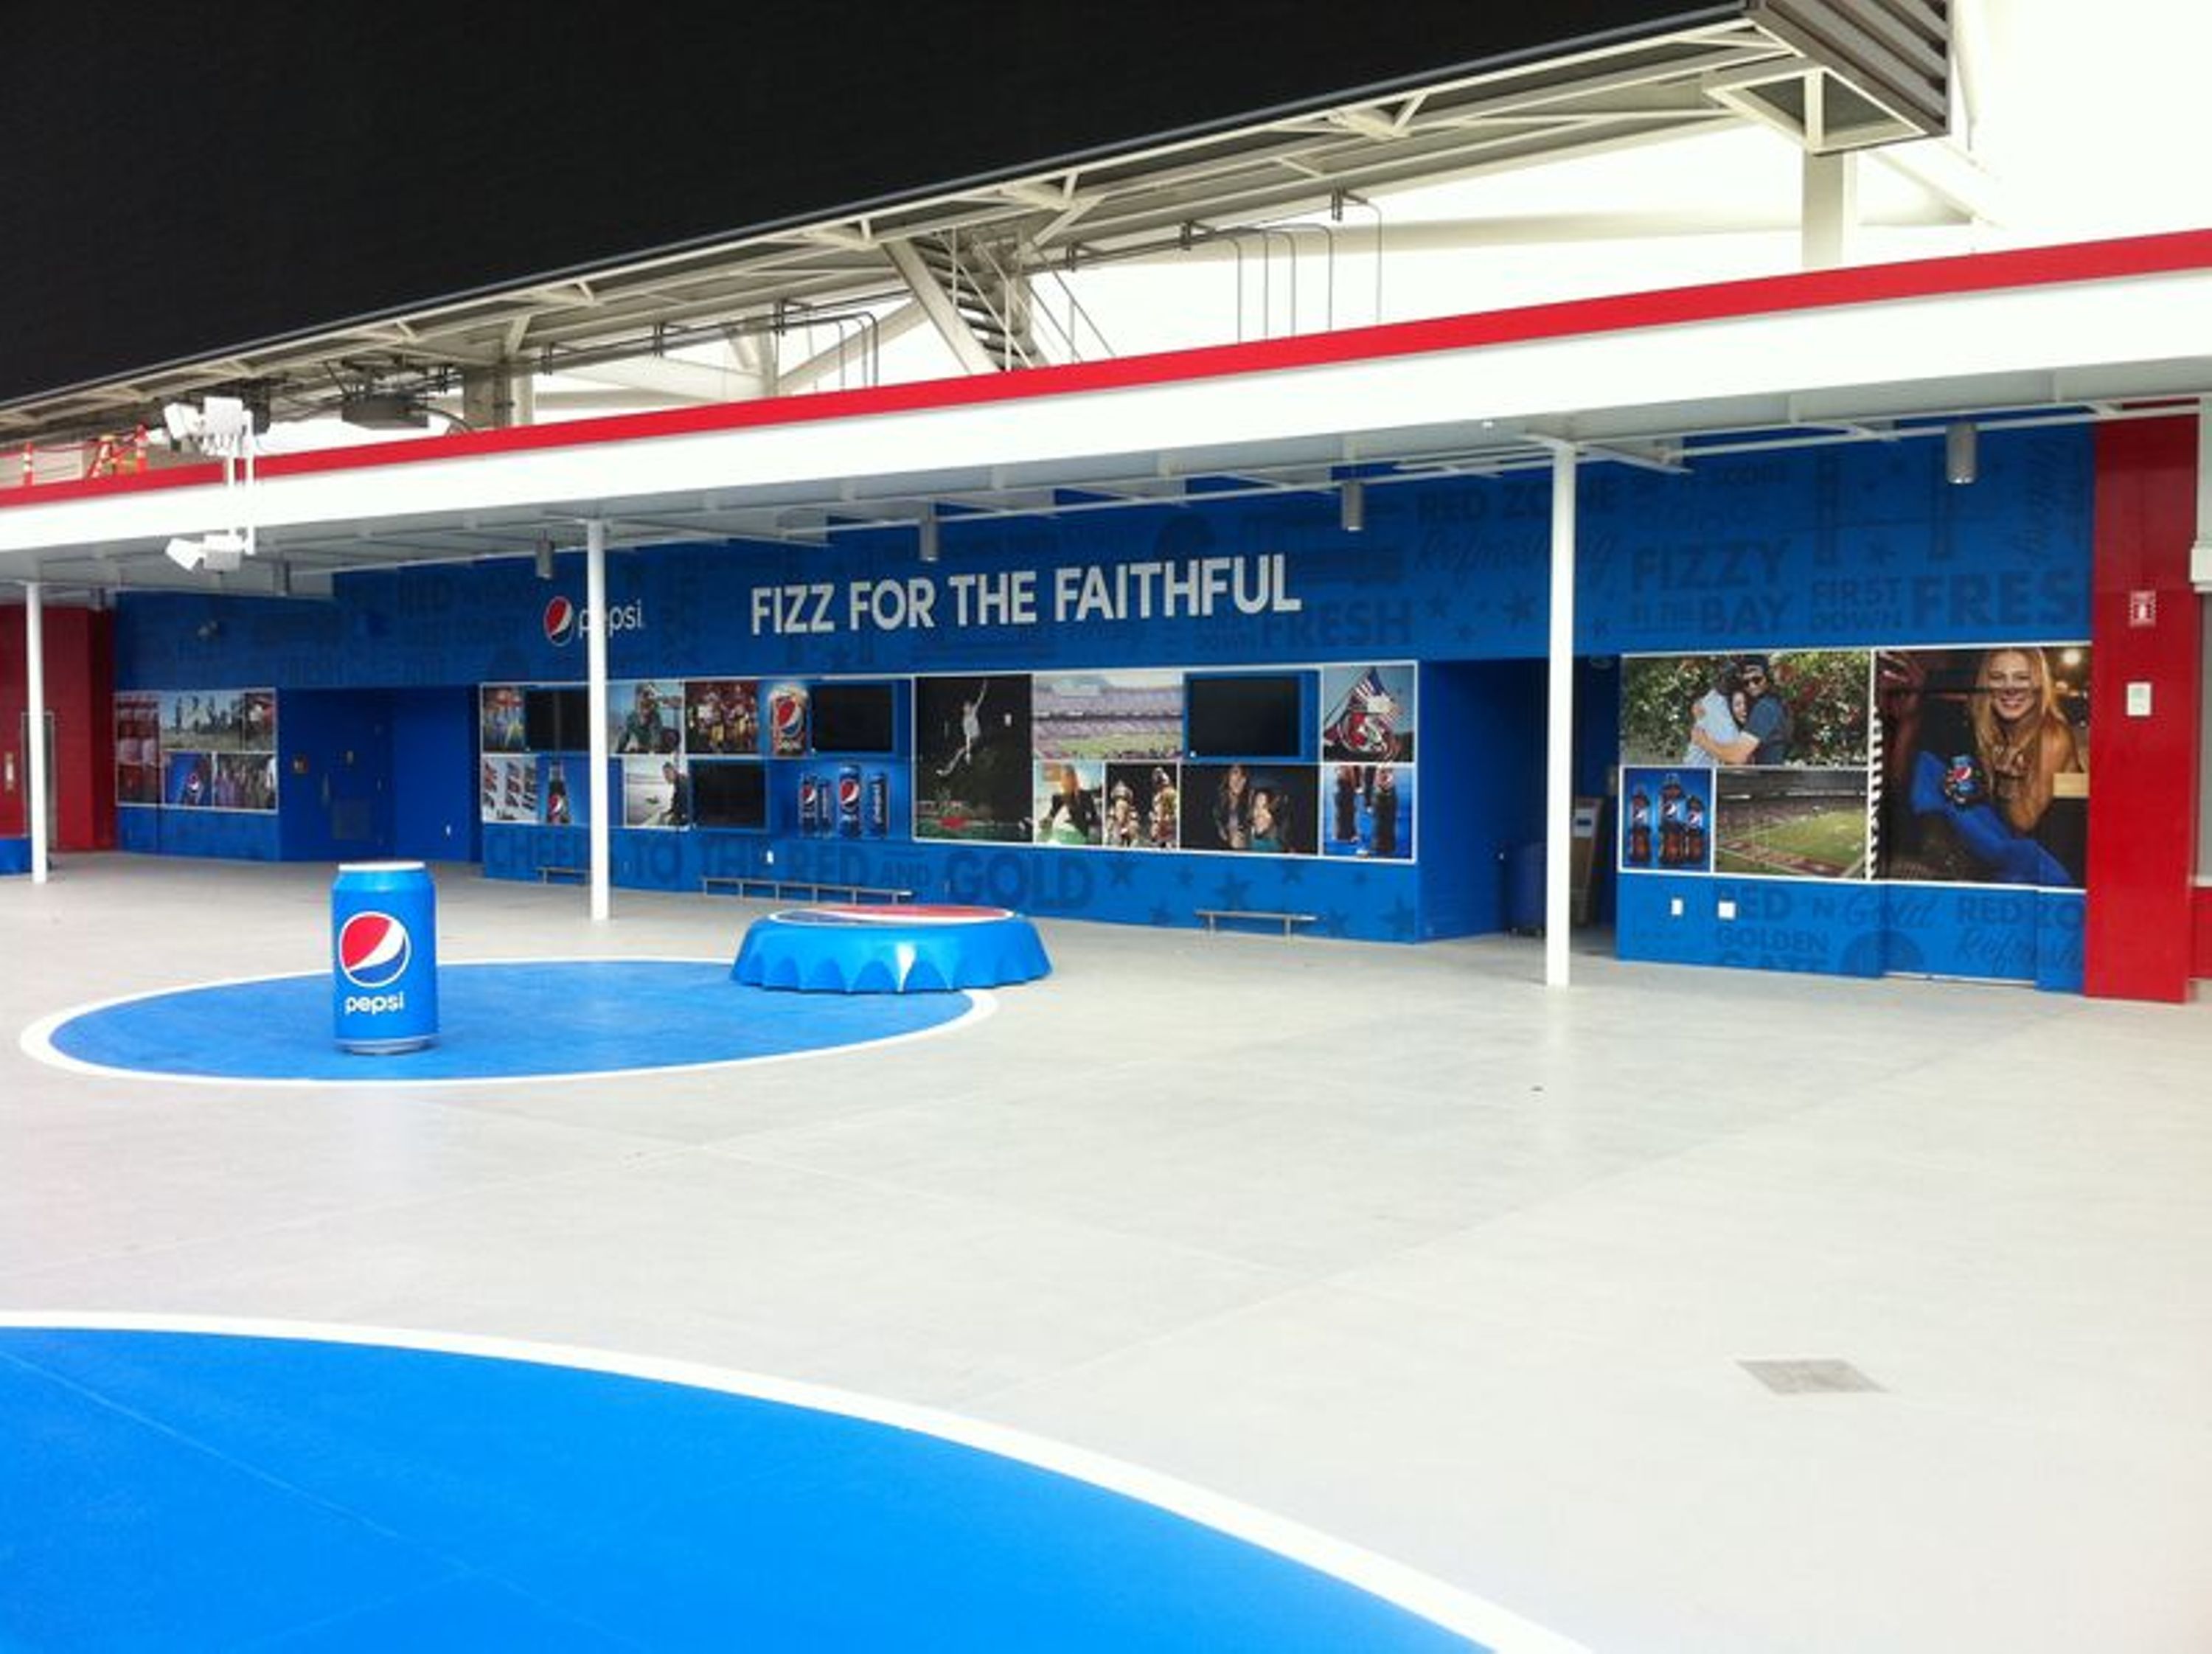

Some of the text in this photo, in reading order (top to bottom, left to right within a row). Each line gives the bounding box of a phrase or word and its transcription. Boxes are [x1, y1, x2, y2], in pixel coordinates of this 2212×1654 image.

[1632, 540, 1792, 593] FIZZY
[751, 583, 835, 636] FIZZ
[849, 577, 935, 632] FOR
[947, 570, 1037, 627] THE
[1054, 552, 1303, 622] FAITHFUL
[1700, 592, 1793, 635] BAY
[579, 599, 642, 639] ppsi
[945, 850, 1093, 908] GOLD
[1715, 926, 1830, 953] GOLDEN
[344, 991, 405, 1015] pepsi
